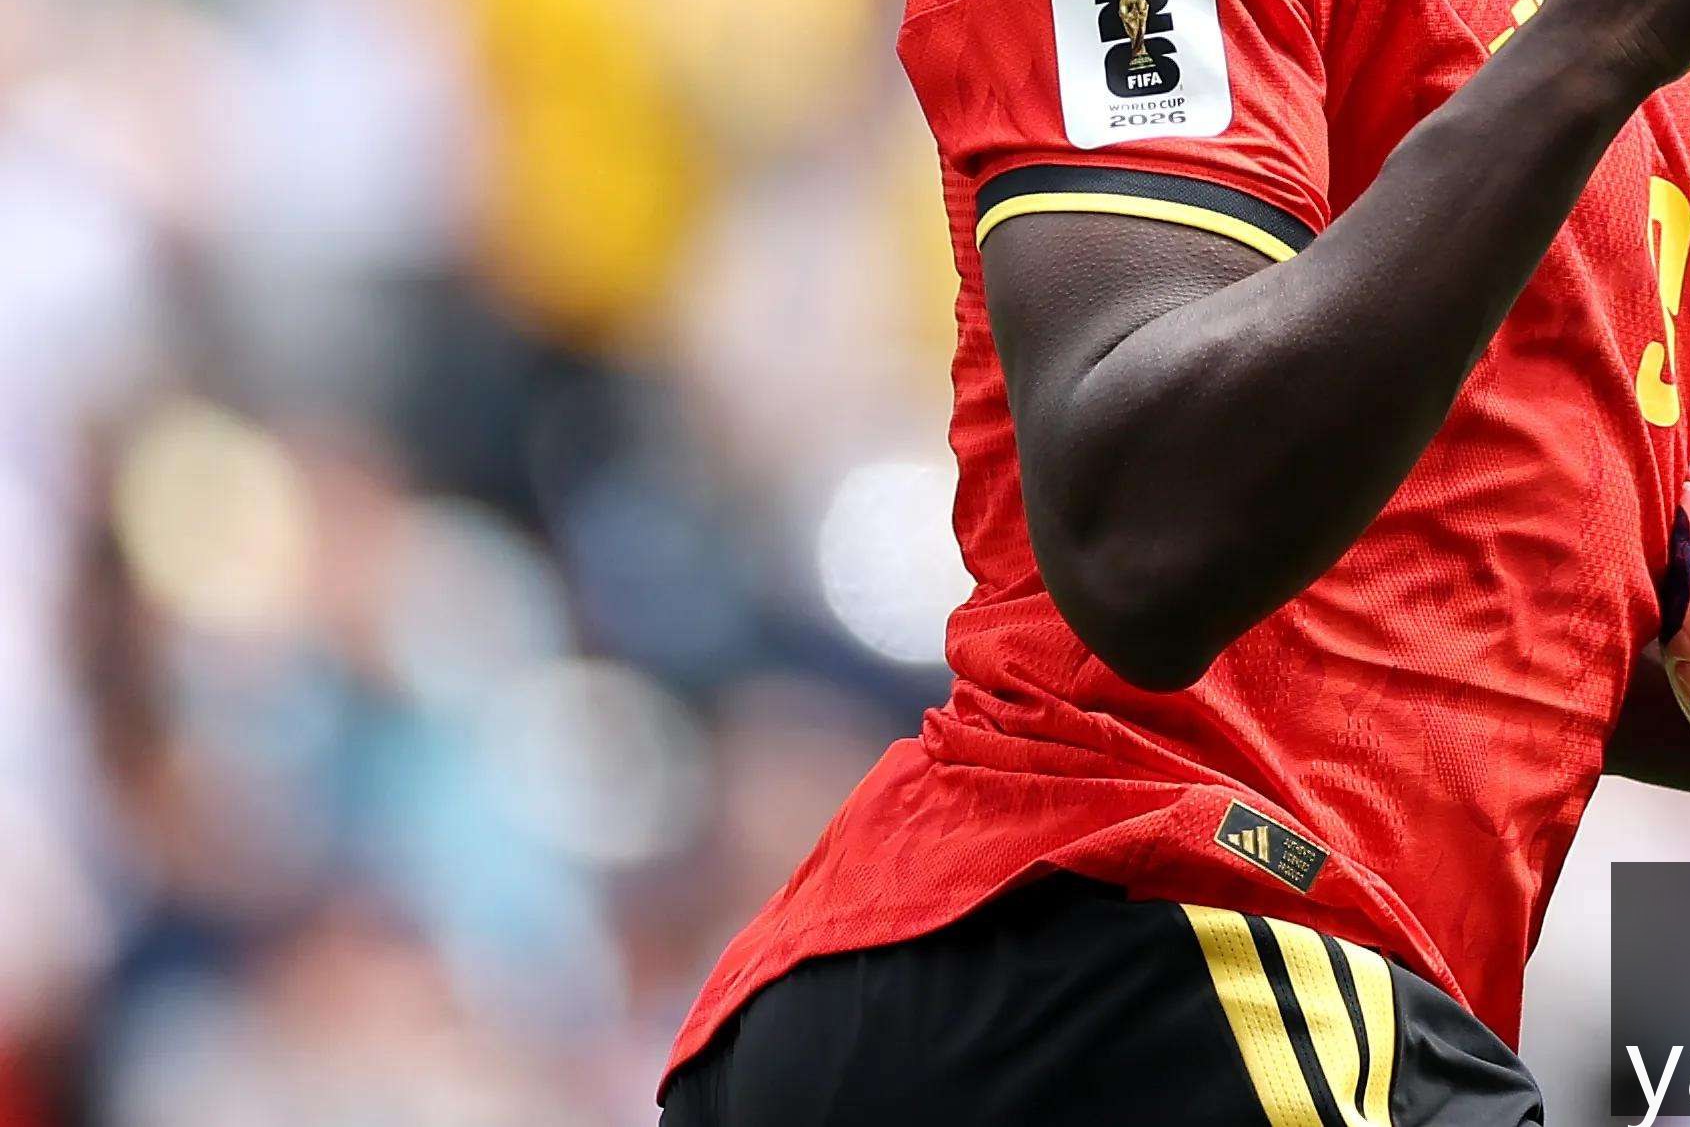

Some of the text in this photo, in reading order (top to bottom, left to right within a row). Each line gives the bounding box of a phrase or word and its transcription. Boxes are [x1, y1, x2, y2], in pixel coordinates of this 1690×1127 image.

[1127, 71, 1163, 90] FIFA
[1160, 97, 1185, 109] CUP
[1109, 111, 1186, 128] 2026
